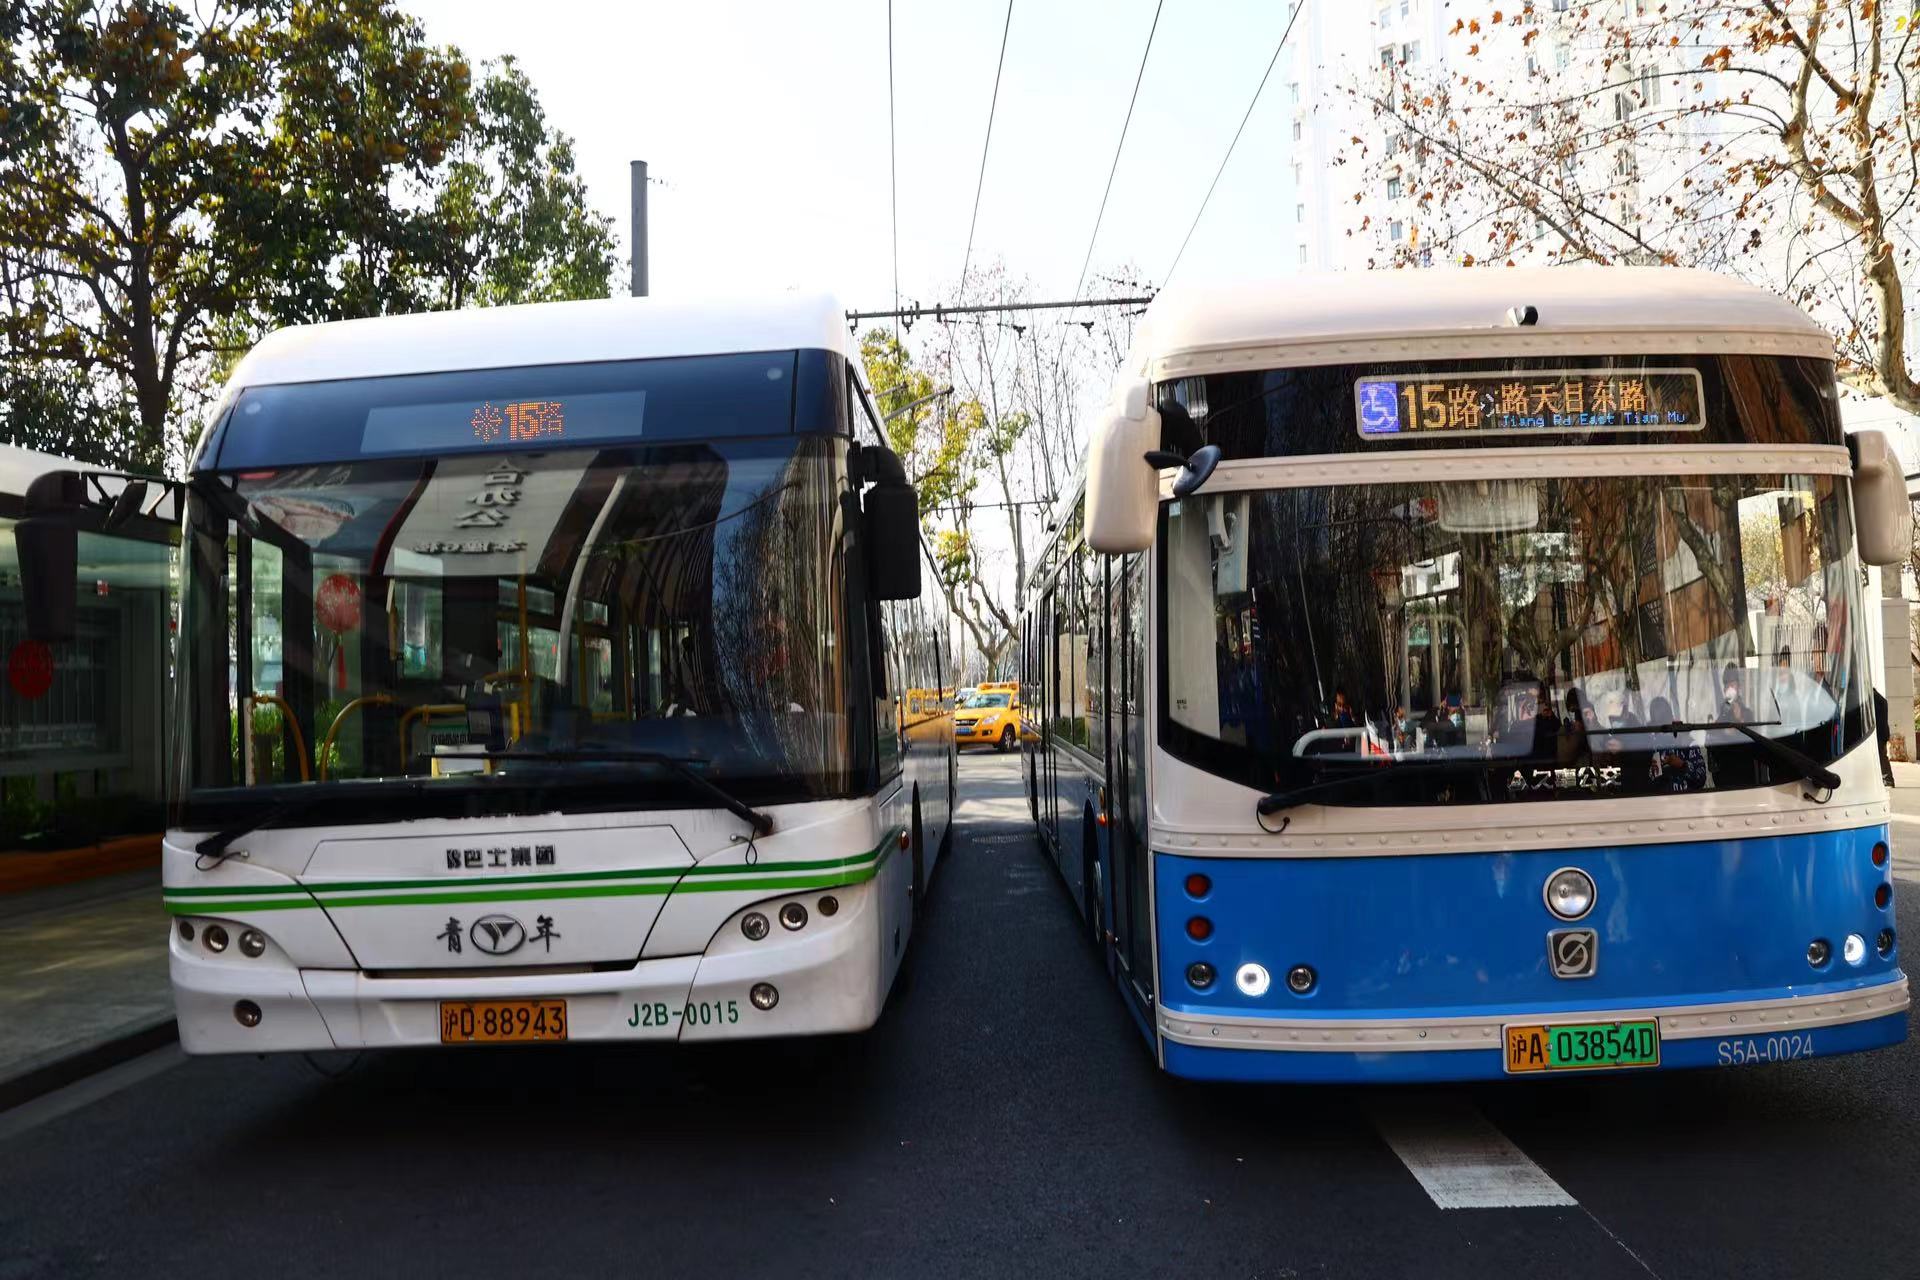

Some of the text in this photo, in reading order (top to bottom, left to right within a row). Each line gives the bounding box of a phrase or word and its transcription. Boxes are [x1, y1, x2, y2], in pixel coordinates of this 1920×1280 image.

[504, 401, 563, 440] 15路
[1401, 384, 1480, 429] 15路
[1501, 415, 1545, 428] Jiang
[1553, 414, 1571, 427] Rd
[1580, 412, 1615, 426] East
[1667, 410, 1686, 424] Mu
[627, 1000, 739, 1028] J2B-0015
[1718, 1033, 1814, 1066] S5A-0024
